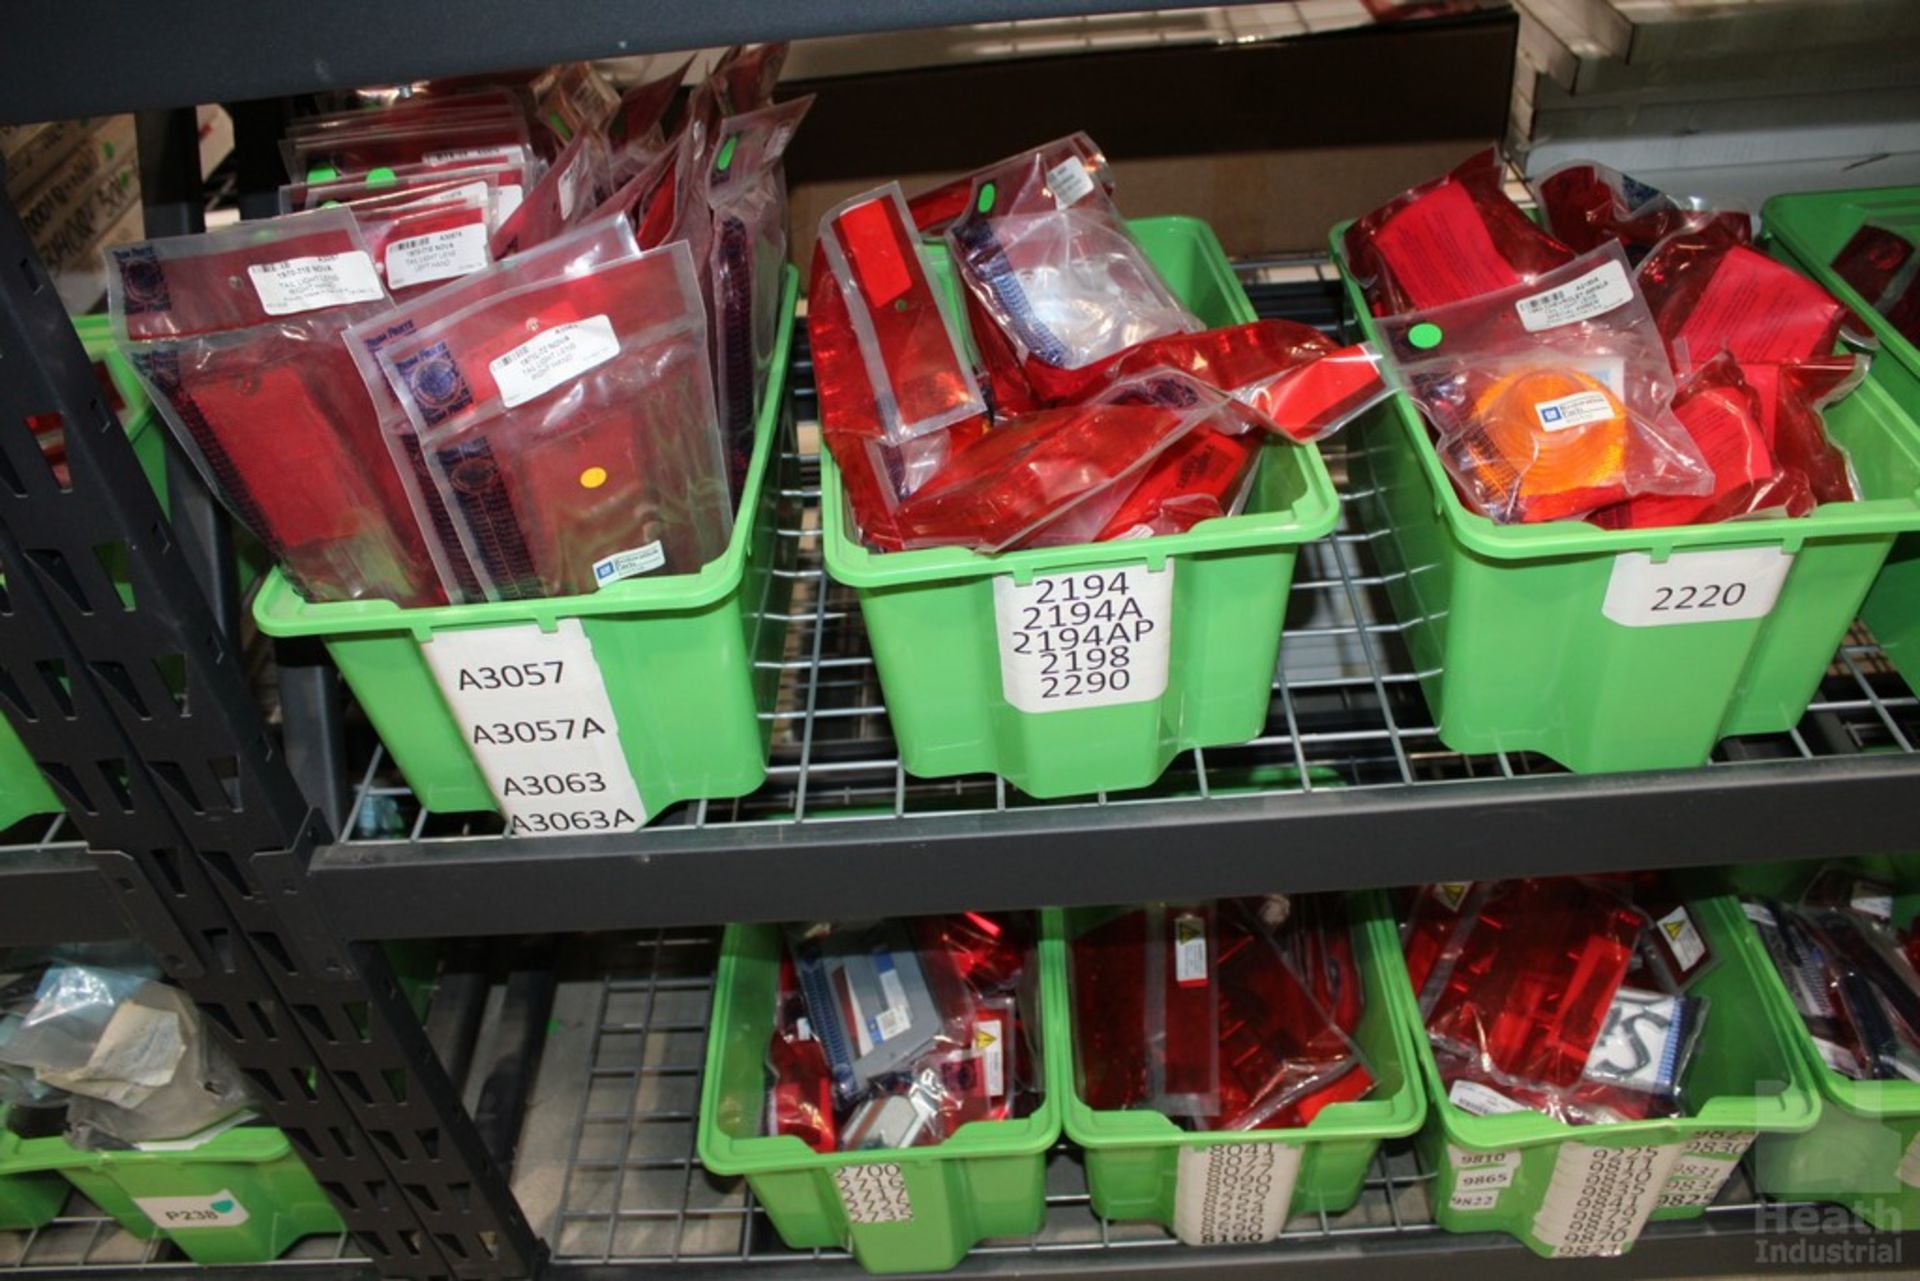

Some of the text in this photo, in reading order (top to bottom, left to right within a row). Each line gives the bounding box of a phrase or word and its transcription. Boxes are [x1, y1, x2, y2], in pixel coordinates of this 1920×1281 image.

[1035, 571, 1130, 604] 2194
[1650, 582, 1746, 612] 2220
[1023, 597, 1143, 631] 2194A
[1012, 619, 1154, 655] 2194AP
[1040, 645, 1130, 675] 2198
[458, 660, 564, 692] A3057
[1041, 669, 1130, 699] 2290
[473, 717, 606, 746] A3057A
[503, 772, 606, 797] A3063
[511, 808, 635, 834] A3063A
[1463, 1173, 1507, 1185] 9865
[165, 1211, 218, 1220] P238
